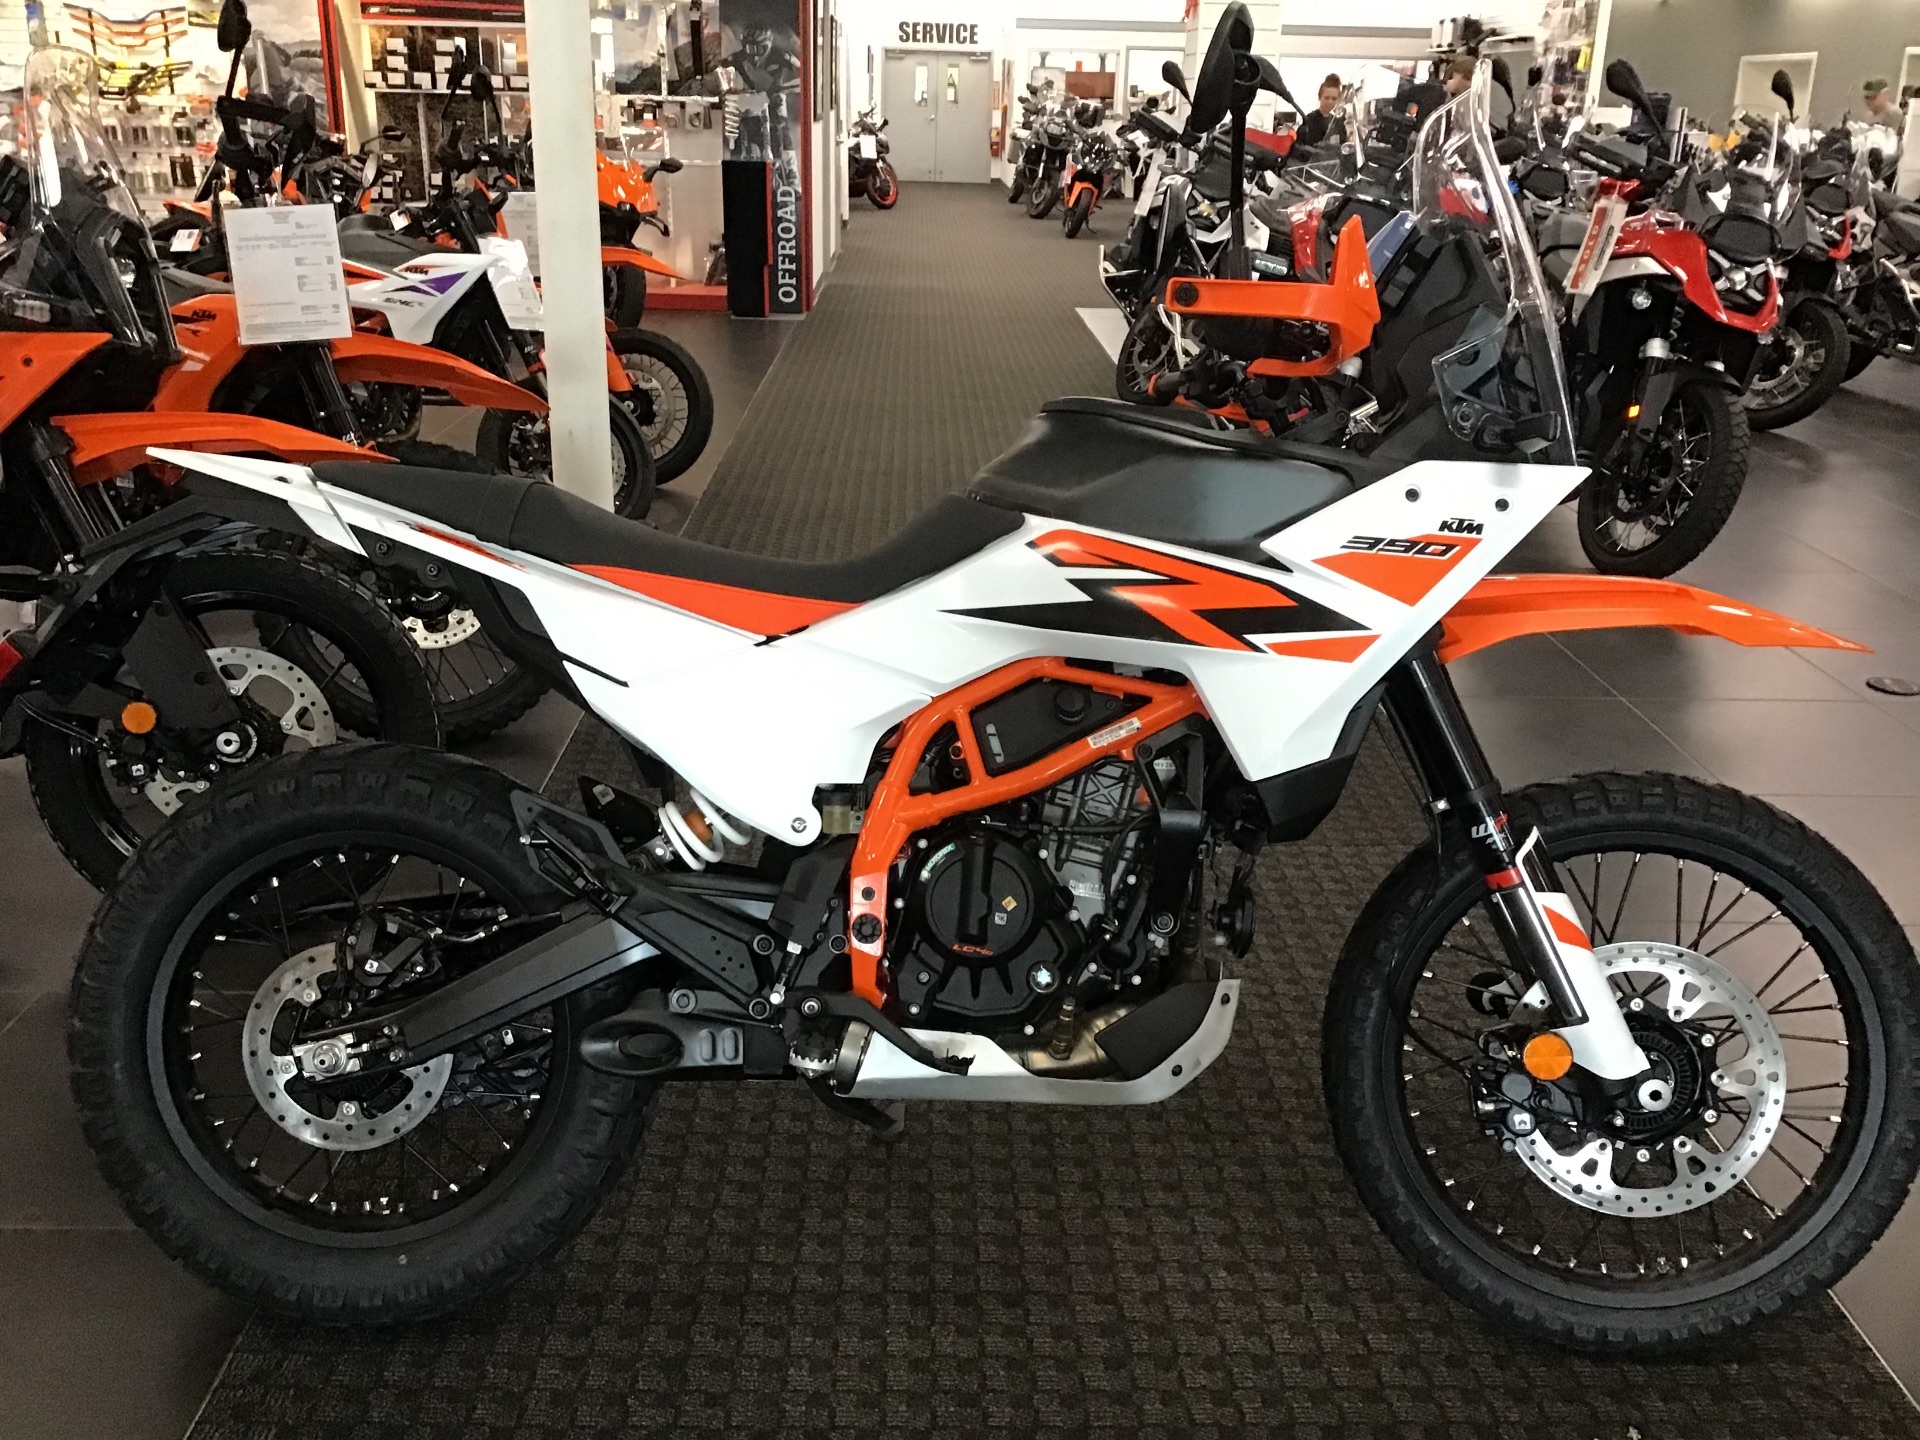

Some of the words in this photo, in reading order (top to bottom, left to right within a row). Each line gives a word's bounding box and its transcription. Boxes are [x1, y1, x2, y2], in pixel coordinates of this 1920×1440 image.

[898, 21, 979, 45] SERVICE
[777, 185, 797, 303] OFFROAD
[191, 309, 218, 322] KTM
[1438, 518, 1484, 535] KTM
[1340, 535, 1461, 557] 390
